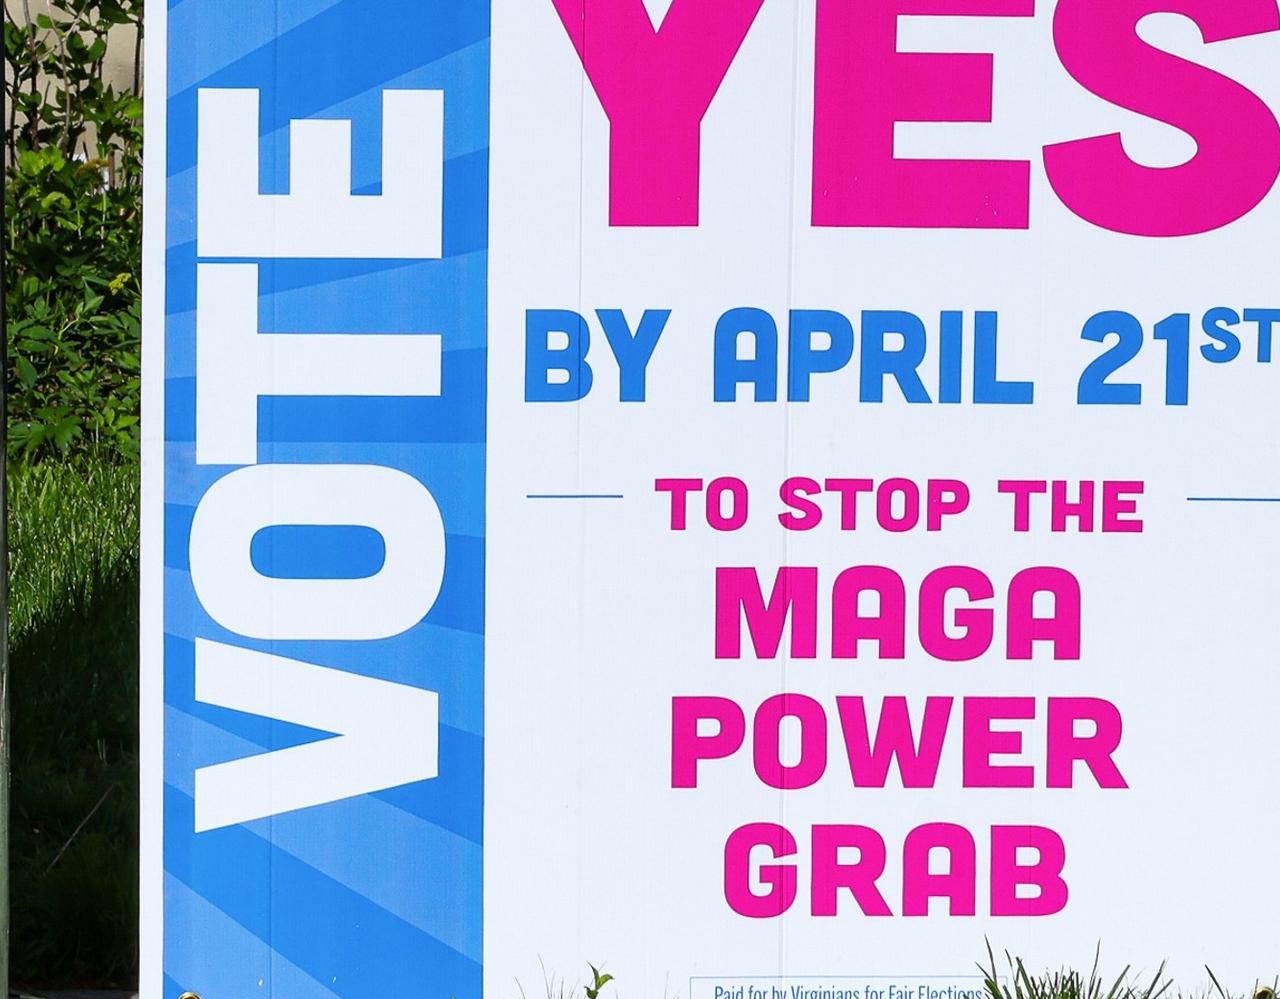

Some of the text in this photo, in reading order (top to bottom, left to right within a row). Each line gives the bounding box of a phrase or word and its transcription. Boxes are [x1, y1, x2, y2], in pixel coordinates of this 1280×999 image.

[524, 308, 672, 403] BY
[713, 306, 1035, 405] APRIL
[188, 87, 447, 834] VOTE
[655, 476, 1144, 533] TO STOP THE
[715, 564, 1082, 662] MAGA
[670, 692, 1130, 790] POWER
[724, 822, 1070, 919] GRAB
